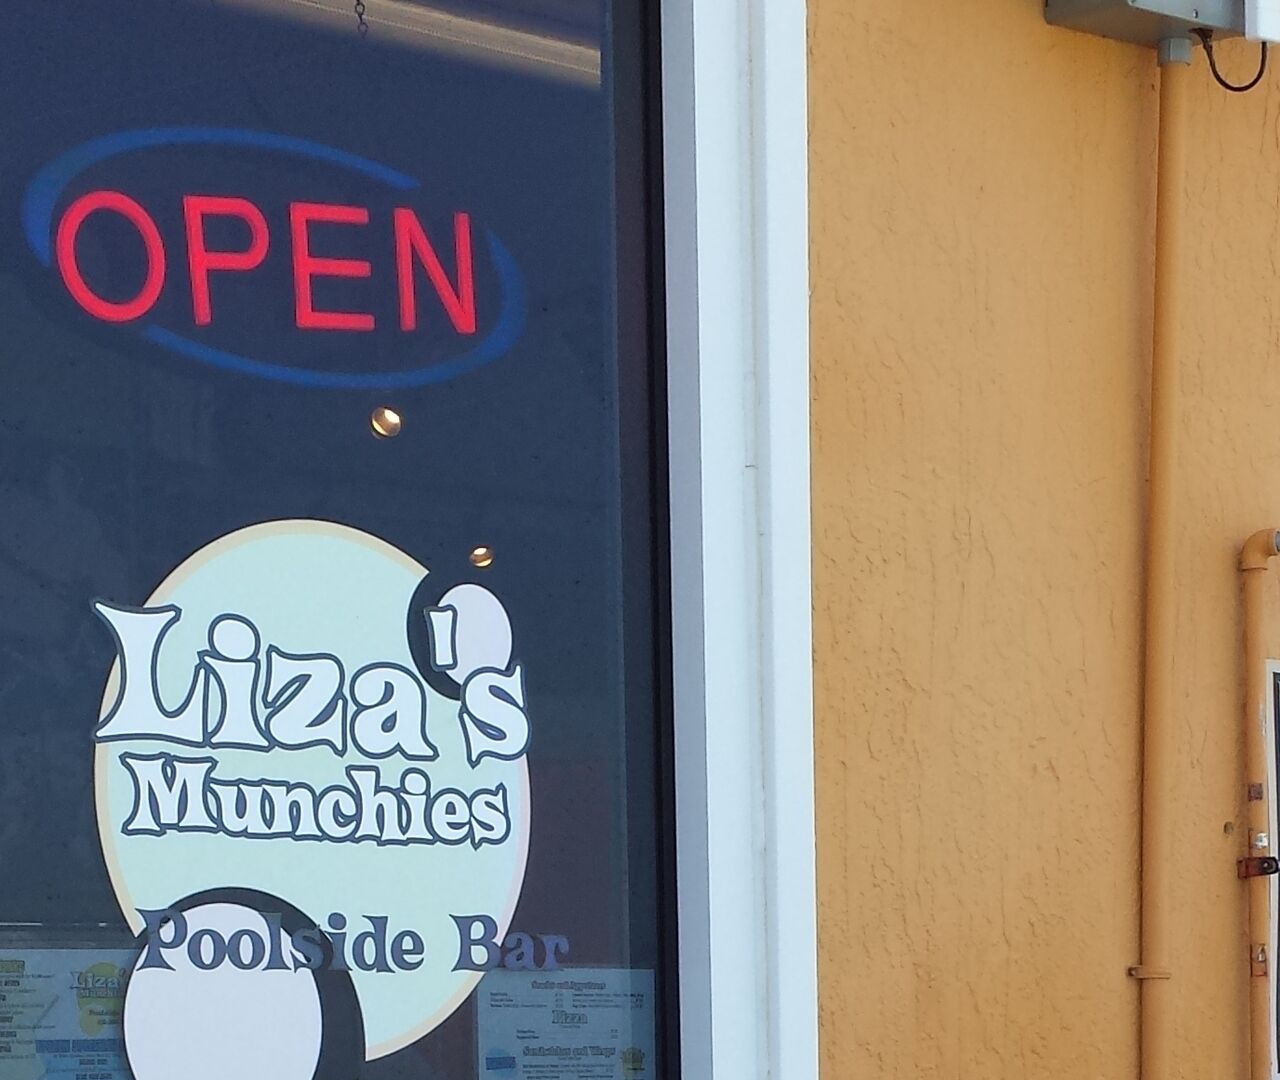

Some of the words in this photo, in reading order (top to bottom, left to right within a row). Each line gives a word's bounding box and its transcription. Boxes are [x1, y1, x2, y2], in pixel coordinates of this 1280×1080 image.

[56, 190, 477, 335] OPEN
[92, 598, 531, 767] Liza's
[120, 752, 511, 849] Munchies
[136, 908, 425, 973] Poolside
[449, 913, 571, 973] Bar
